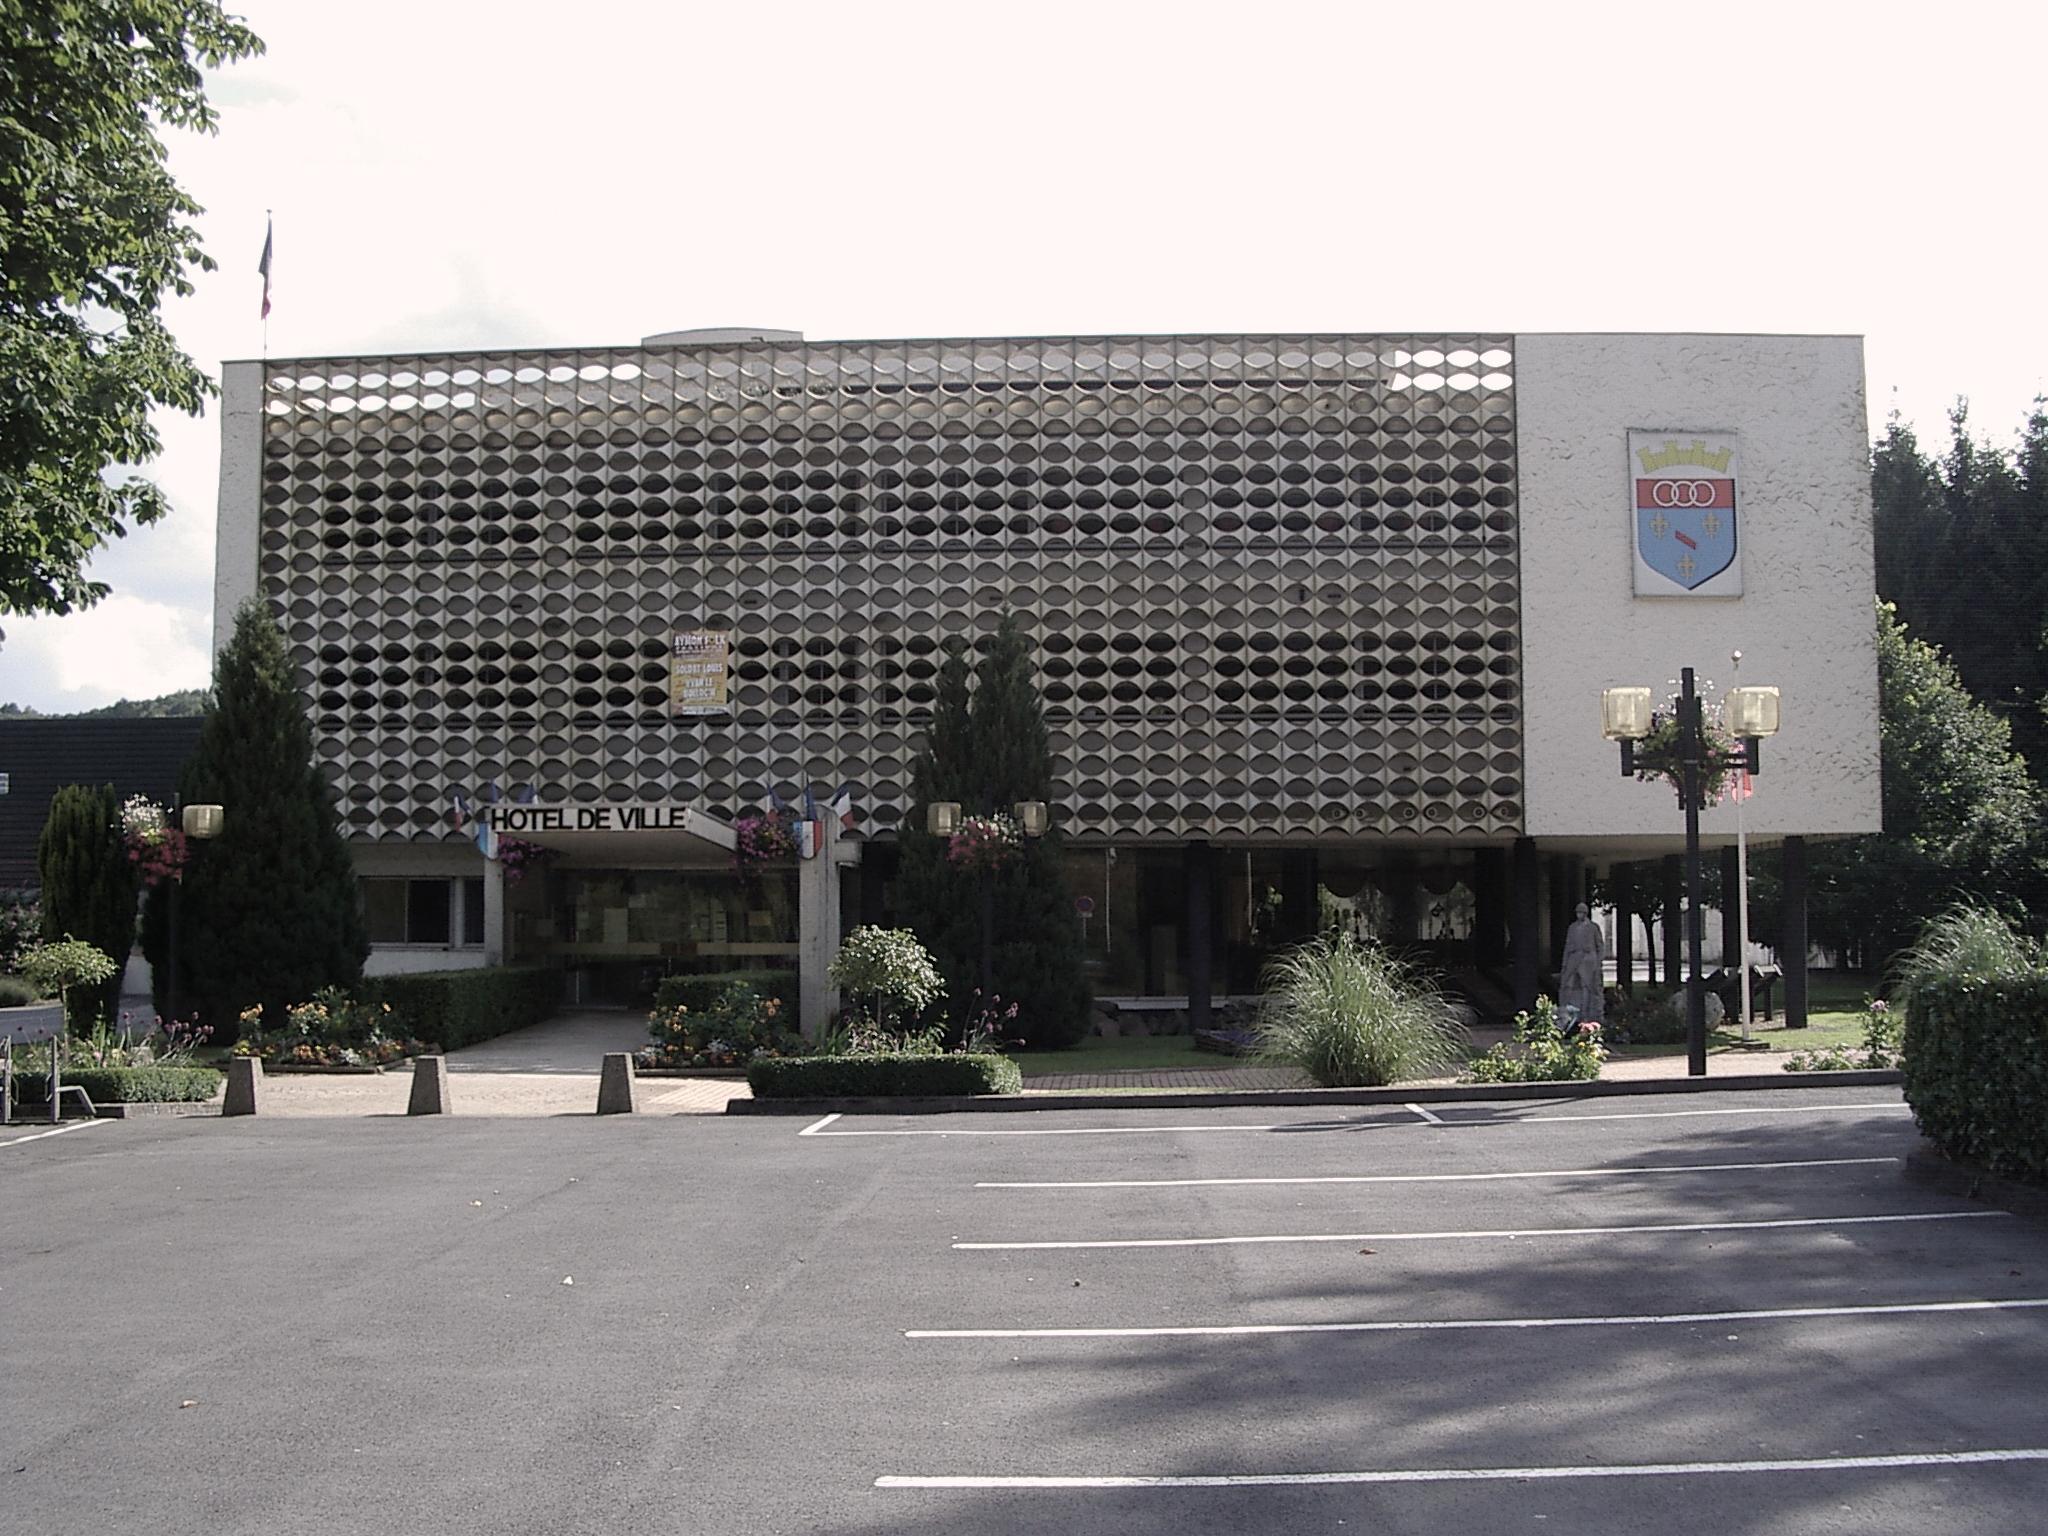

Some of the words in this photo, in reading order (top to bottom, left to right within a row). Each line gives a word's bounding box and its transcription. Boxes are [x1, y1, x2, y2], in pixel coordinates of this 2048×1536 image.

[491, 808, 573, 830] HOTEL
[577, 808, 611, 829] DE
[617, 807, 686, 829] VILLE
